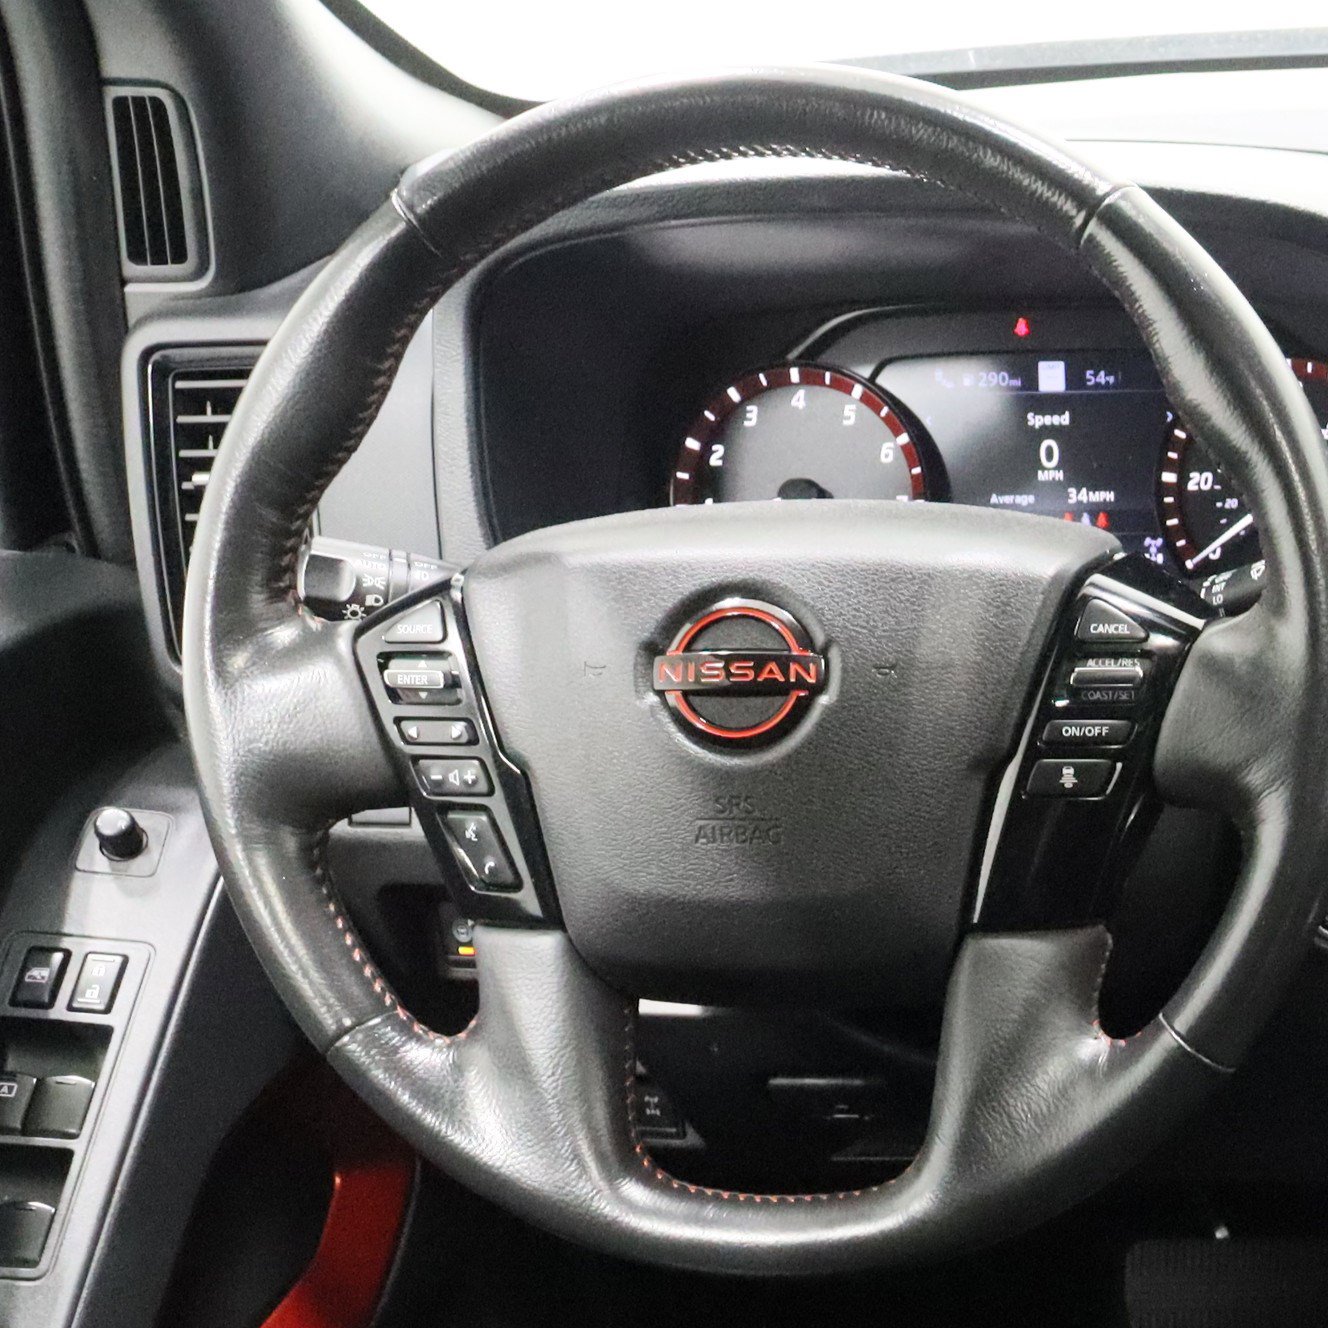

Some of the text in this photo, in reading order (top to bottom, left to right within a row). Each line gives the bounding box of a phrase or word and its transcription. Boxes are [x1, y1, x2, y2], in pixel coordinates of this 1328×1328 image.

[790, 389, 806, 409] 4
[743, 405, 758, 427] 3
[842, 404, 856, 426] 5
[1026, 410, 1070, 429] Speed
[708, 444, 725, 467] 2
[880, 442, 894, 463] 6
[1039, 438, 1060, 469] 0
[1037, 470, 1064, 482] MPH
[1187, 471, 1213, 491] 20
[396, 623, 433, 635] SOURCE
[1090, 623, 1131, 635] CANCEL
[397, 674, 428, 685] ENTER
[658, 660, 818, 684] NISSAN
[1061, 726, 1110, 738] ON/OFF
[713, 797, 754, 816] SRS
[694, 826, 783, 846] AIRBAG
